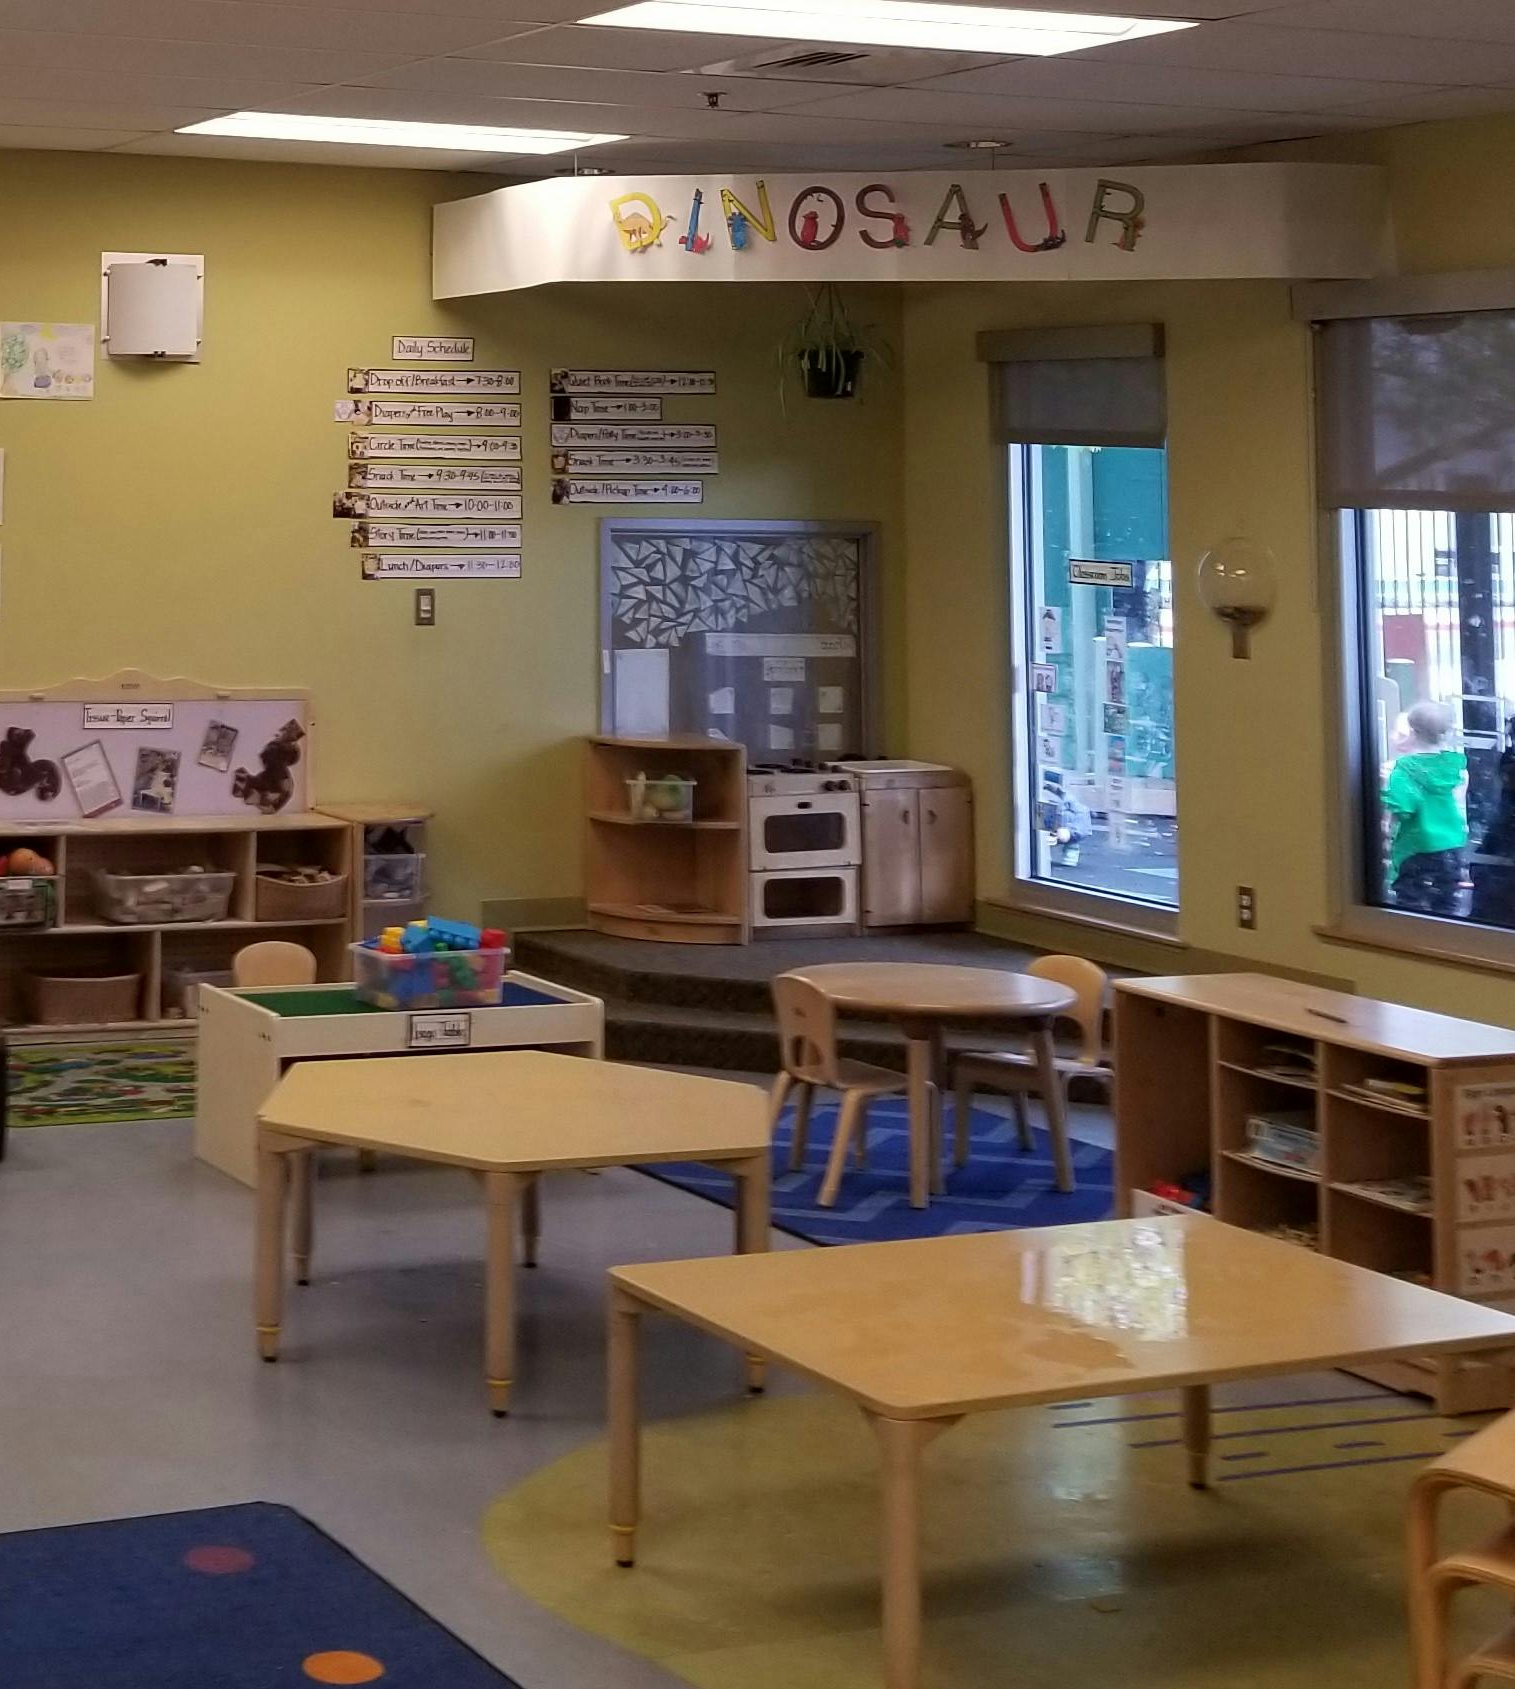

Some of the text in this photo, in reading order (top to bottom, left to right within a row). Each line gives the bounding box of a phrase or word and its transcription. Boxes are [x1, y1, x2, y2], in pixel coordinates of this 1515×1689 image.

[609, 178, 1145, 255] DINOSAUR
[397, 339, 471, 358] Daily Schedule
[370, 372, 393, 389] Drop
[436, 405, 454, 423] Play
[368, 437, 396, 451] Circle
